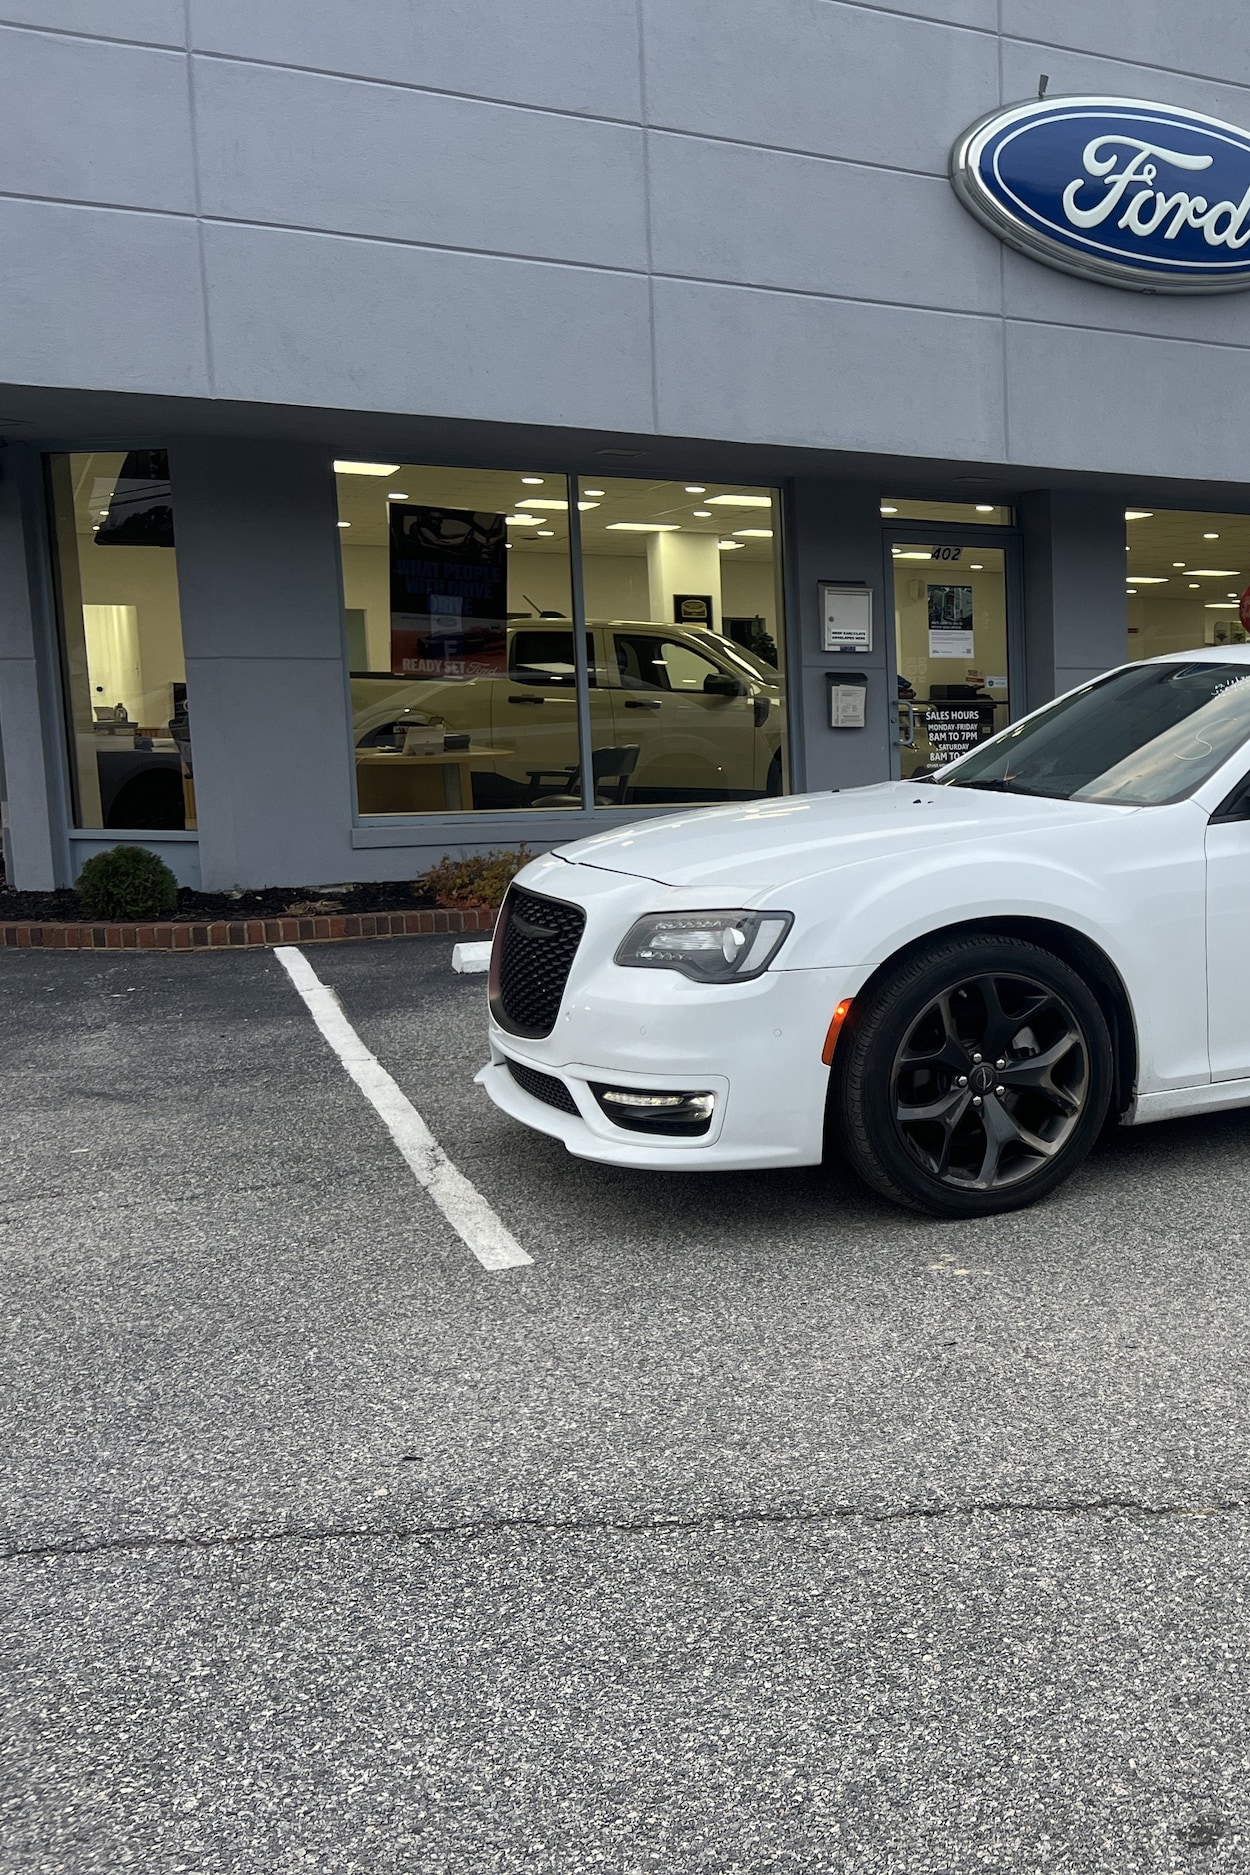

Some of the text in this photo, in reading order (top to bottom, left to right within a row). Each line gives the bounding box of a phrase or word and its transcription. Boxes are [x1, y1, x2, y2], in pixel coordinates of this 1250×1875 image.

[931, 547, 961, 561] 402
[396, 559, 502, 584] WHAT PEOPLE
[448, 580, 494, 600] DRIVE
[402, 657, 441, 674] READY
[444, 660, 466, 674] SET
[926, 710, 980, 721] SALES HOURS
[928, 723, 979, 732] MONDAY-FRIDAY
[929, 731, 978, 742] 8AM TO 7PM
[938, 743, 970, 751] SATURDAY
[930, 752, 948, 762] 8AM
[949, 752, 961, 761] TO
